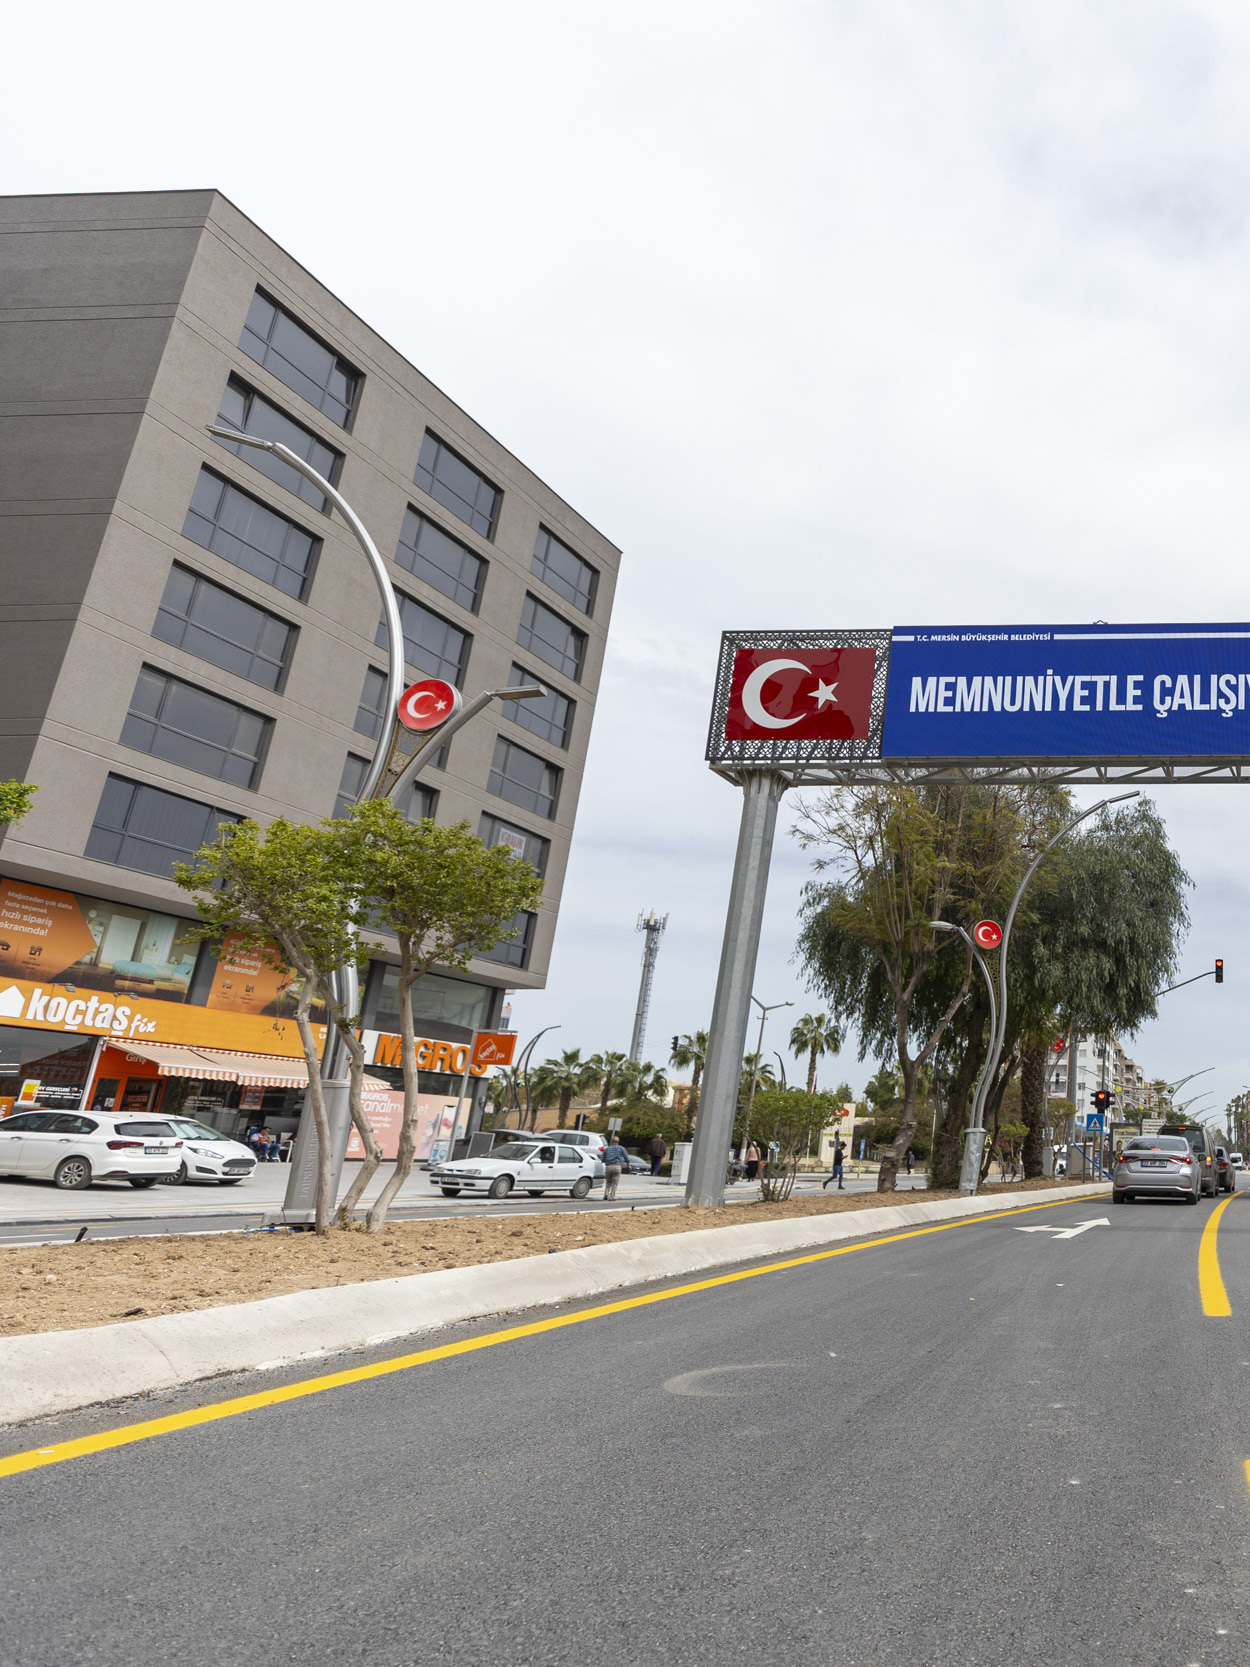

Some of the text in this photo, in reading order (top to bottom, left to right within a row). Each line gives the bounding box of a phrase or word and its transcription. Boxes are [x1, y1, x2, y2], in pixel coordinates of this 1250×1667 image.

[930, 633, 960, 642] MERSİN
[961, 632, 1009, 642] BÜYÜKŞEHİR
[1010, 632, 1051, 641] BELEDİYESİ
[909, 668, 1145, 713] MEMNUNİYETLE
[4, 900, 48, 914] fazla seçenek
[8, 890, 45, 905] Mağazadan
[56, 902, 73, 910] daha
[1, 908, 53, 927] hızlı sipariş
[0, 921, 48, 937] ekranında!
[25, 988, 157, 1037] koçtaş fix
[126, 1053, 148, 1065] Giriş
[374, 1033, 488, 1076] MGRO
